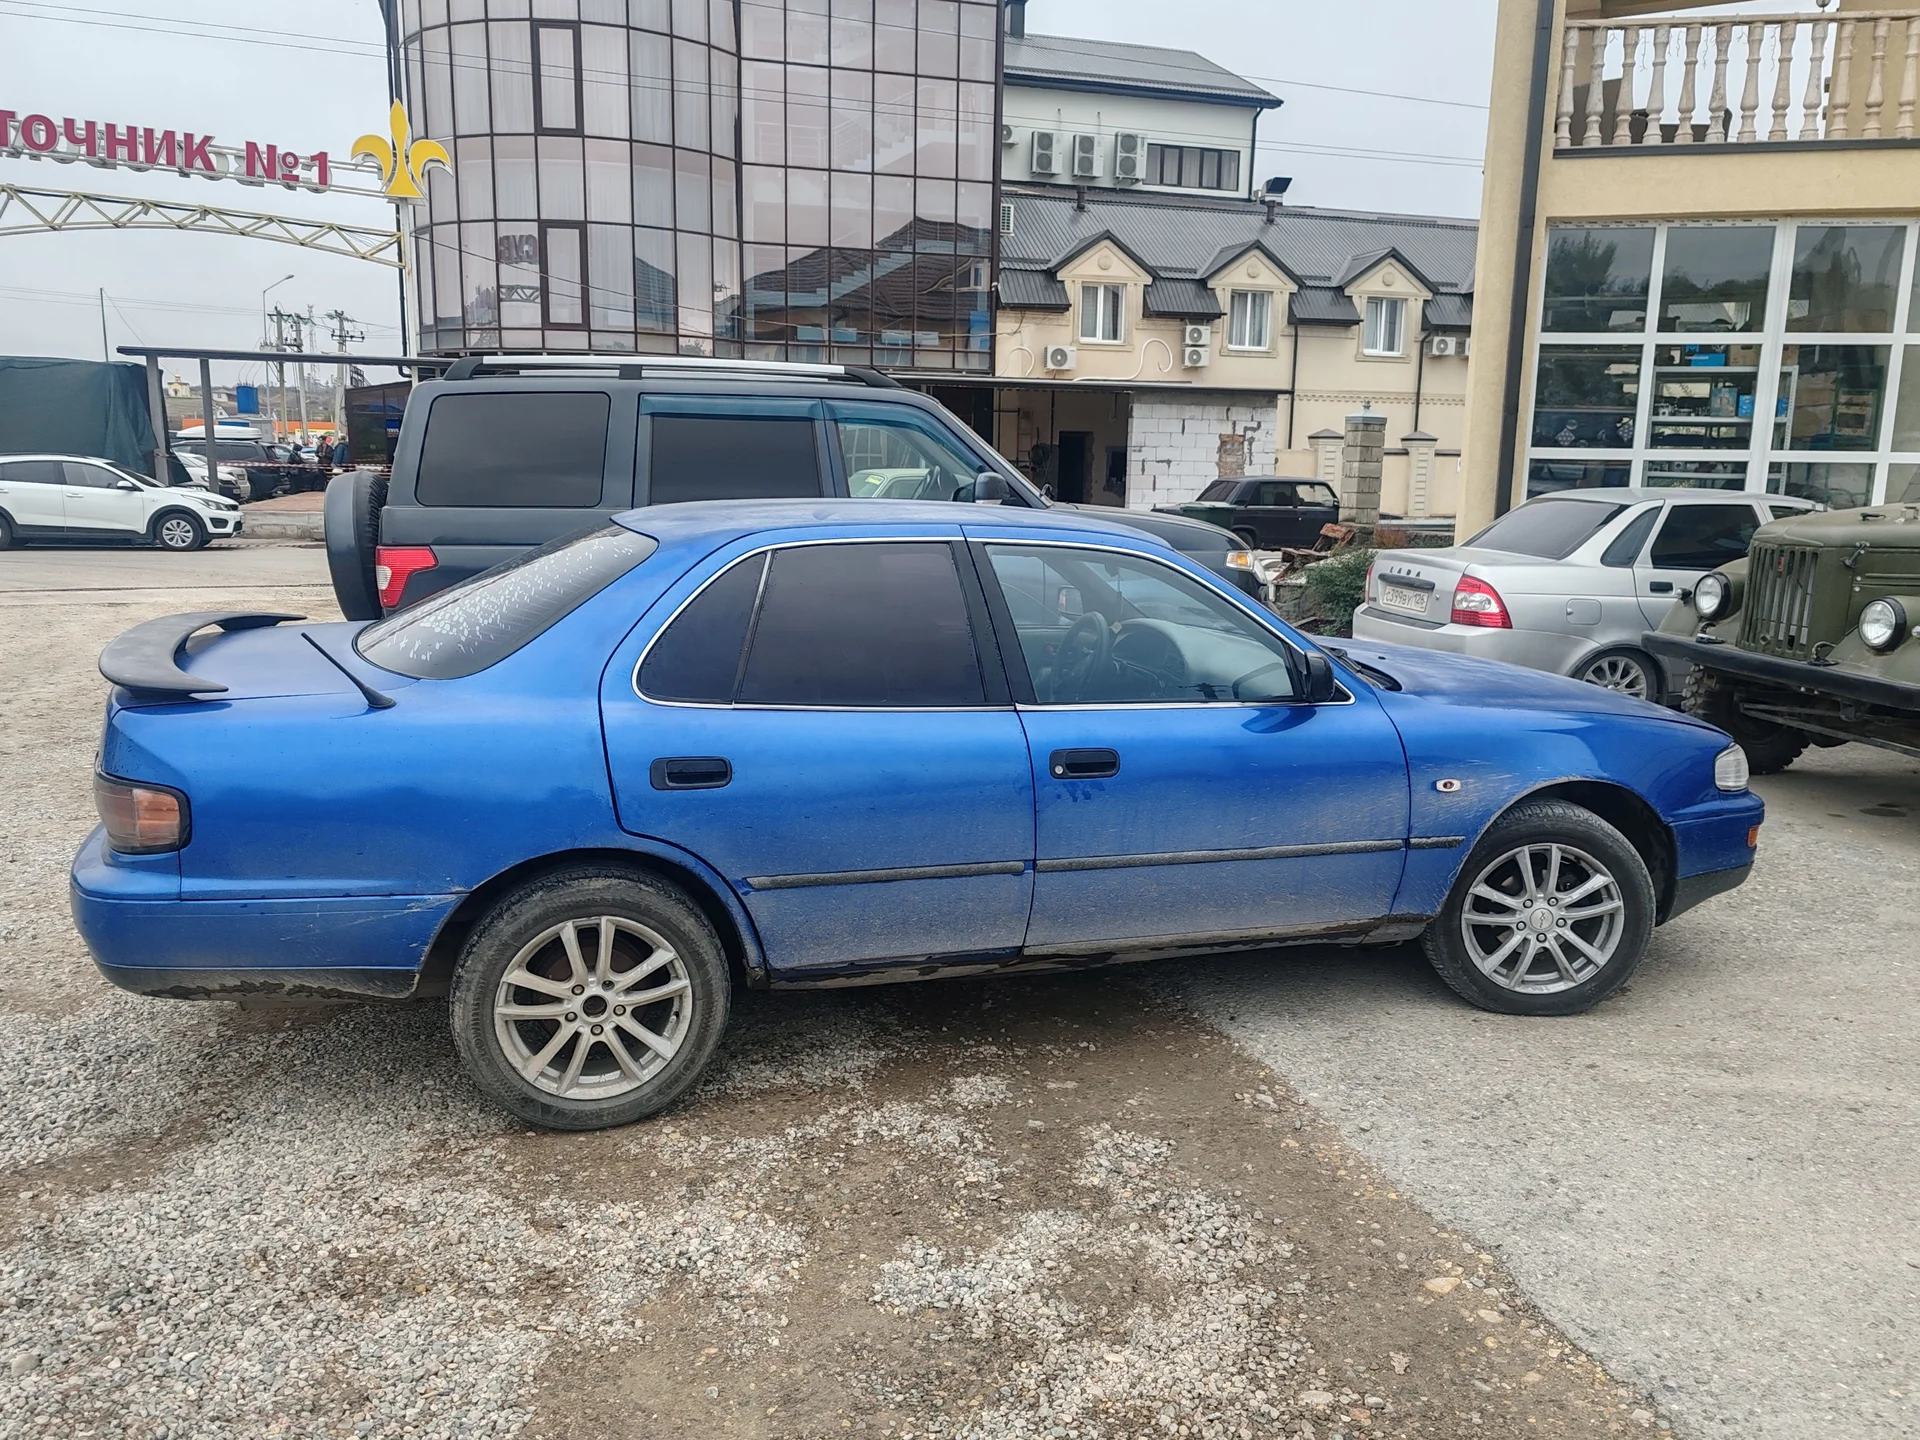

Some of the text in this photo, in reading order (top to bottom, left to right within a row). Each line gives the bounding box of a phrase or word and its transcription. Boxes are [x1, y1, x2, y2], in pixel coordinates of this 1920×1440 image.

[245, 141, 329, 186] №1
[1390, 566, 1421, 577] LADA
[1413, 593, 1425, 606] 126
